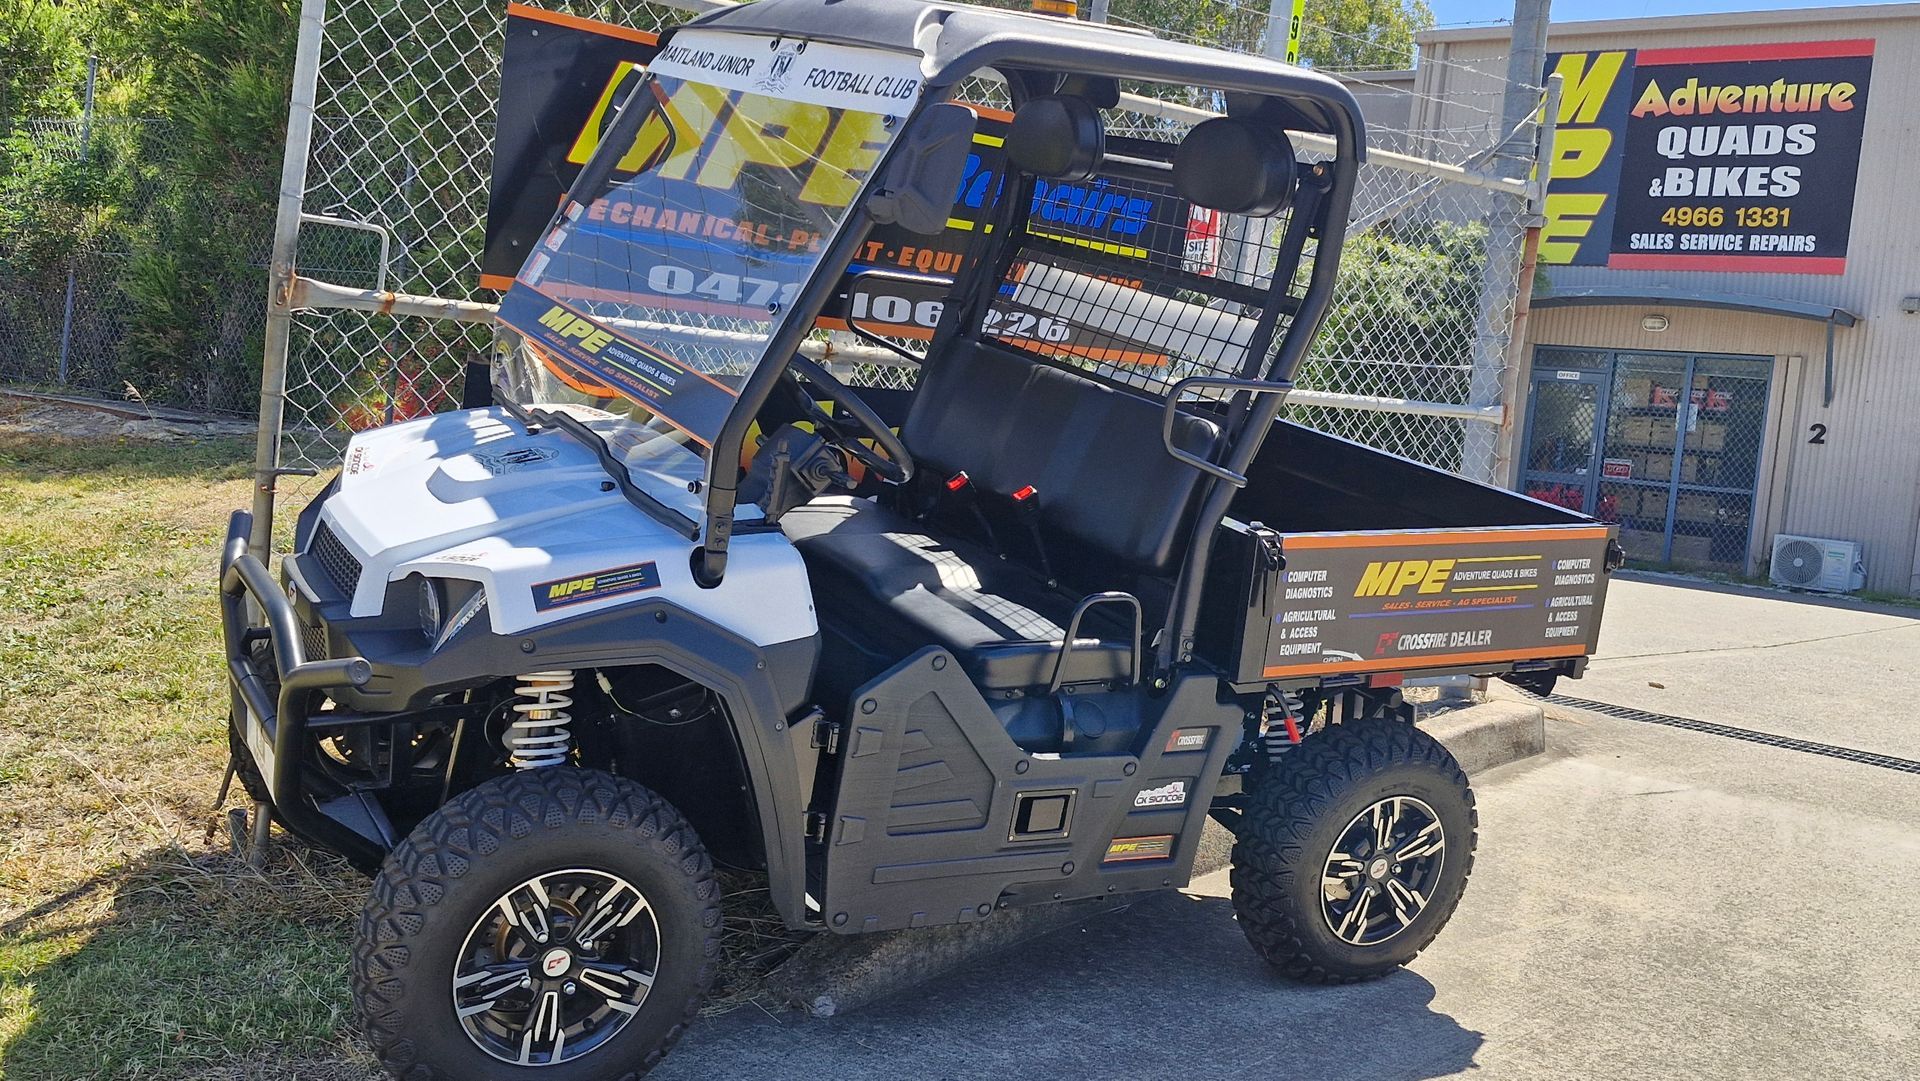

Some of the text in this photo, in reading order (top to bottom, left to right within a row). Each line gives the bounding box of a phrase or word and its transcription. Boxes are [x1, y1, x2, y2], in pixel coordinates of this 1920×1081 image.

[658, 46, 755, 76] MAITLAND JUNIOR
[804, 68, 871, 94] FOOTBALL
[874, 76, 918, 100] CLUB
[1630, 77, 1857, 118] Adventure
[1656, 123, 1817, 159] QUADS
[1526, 52, 1627, 263] MPE
[559, 193, 770, 246] ECHANICAL
[1661, 207, 1791, 227] 4966 1331
[1630, 233, 1816, 252] SALES SERVICE REPAIRS
[538, 305, 615, 354] MPE
[606, 346, 639, 367] ADVENTURE
[637, 358, 656, 375] QUADS
[659, 370, 676, 387] BIKES
[615, 370, 661, 399] SPECIALIST
[1807, 423, 1827, 444] 2
[1557, 558, 1591, 570] COMPUTER
[1288, 570, 1327, 582] COMPUTER
[1353, 559, 1456, 597] MPE
[1453, 568, 1538, 581] ADVENTURE QUADS & BIKES
[1554, 573, 1595, 585] DIAGNOSTICS
[548, 577, 596, 599] MPE
[1285, 586, 1333, 599] DIAGNOSTICS
[1382, 596, 1517, 610] SALES SERVICE AG SPECIALIST
[1550, 595, 1593, 607] AGRICULTURAL
[1282, 609, 1336, 623] AGRICULTURAL
[1547, 611, 1578, 622] & ACCESS
[1281, 627, 1318, 639] & ACCESS
[1397, 632, 1449, 651] CROSSFIRE
[1450, 629, 1493, 647] DEALER
[1545, 625, 1579, 637] EQUIPMENT
[1280, 643, 1321, 656] EQUIPMENT
[1177, 734, 1206, 746] CROSSFIRE
[1109, 843, 1138, 853] MPE
